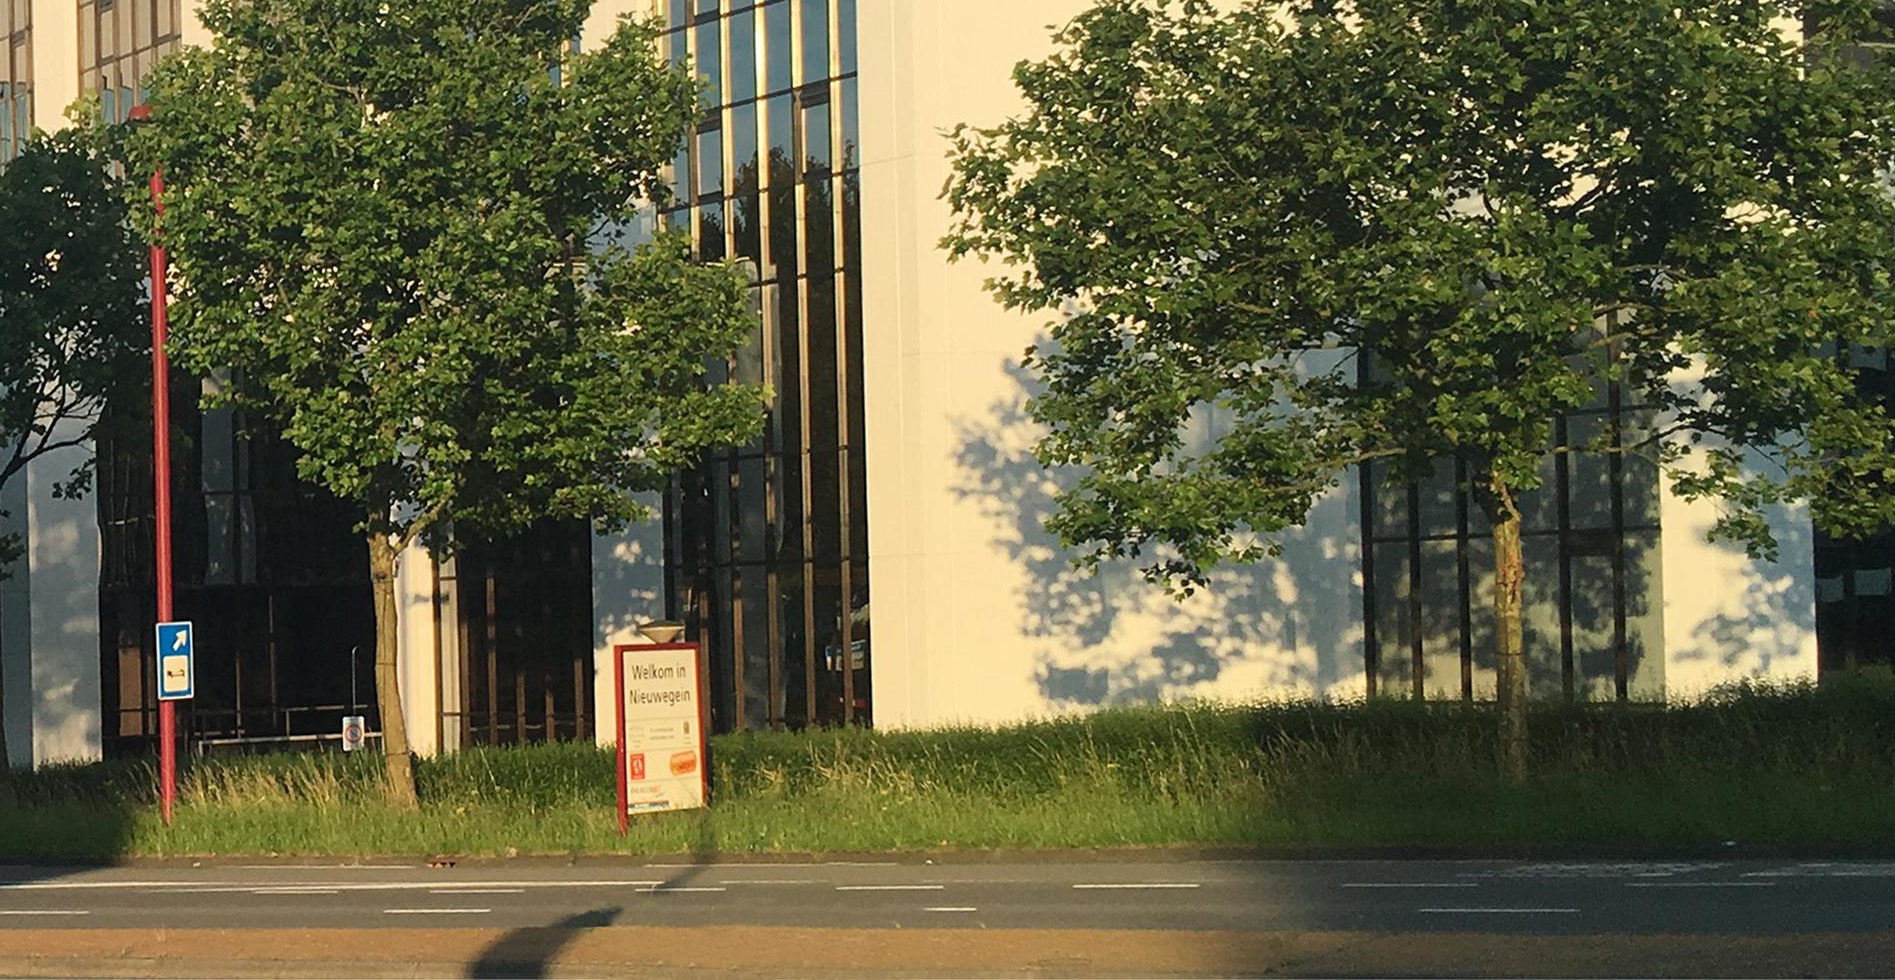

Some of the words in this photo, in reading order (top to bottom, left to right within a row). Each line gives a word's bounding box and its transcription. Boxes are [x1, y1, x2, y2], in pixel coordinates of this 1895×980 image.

[631, 663, 674, 680] Welkom
[676, 663, 686, 678] in
[630, 688, 691, 707] Nieuwegein
